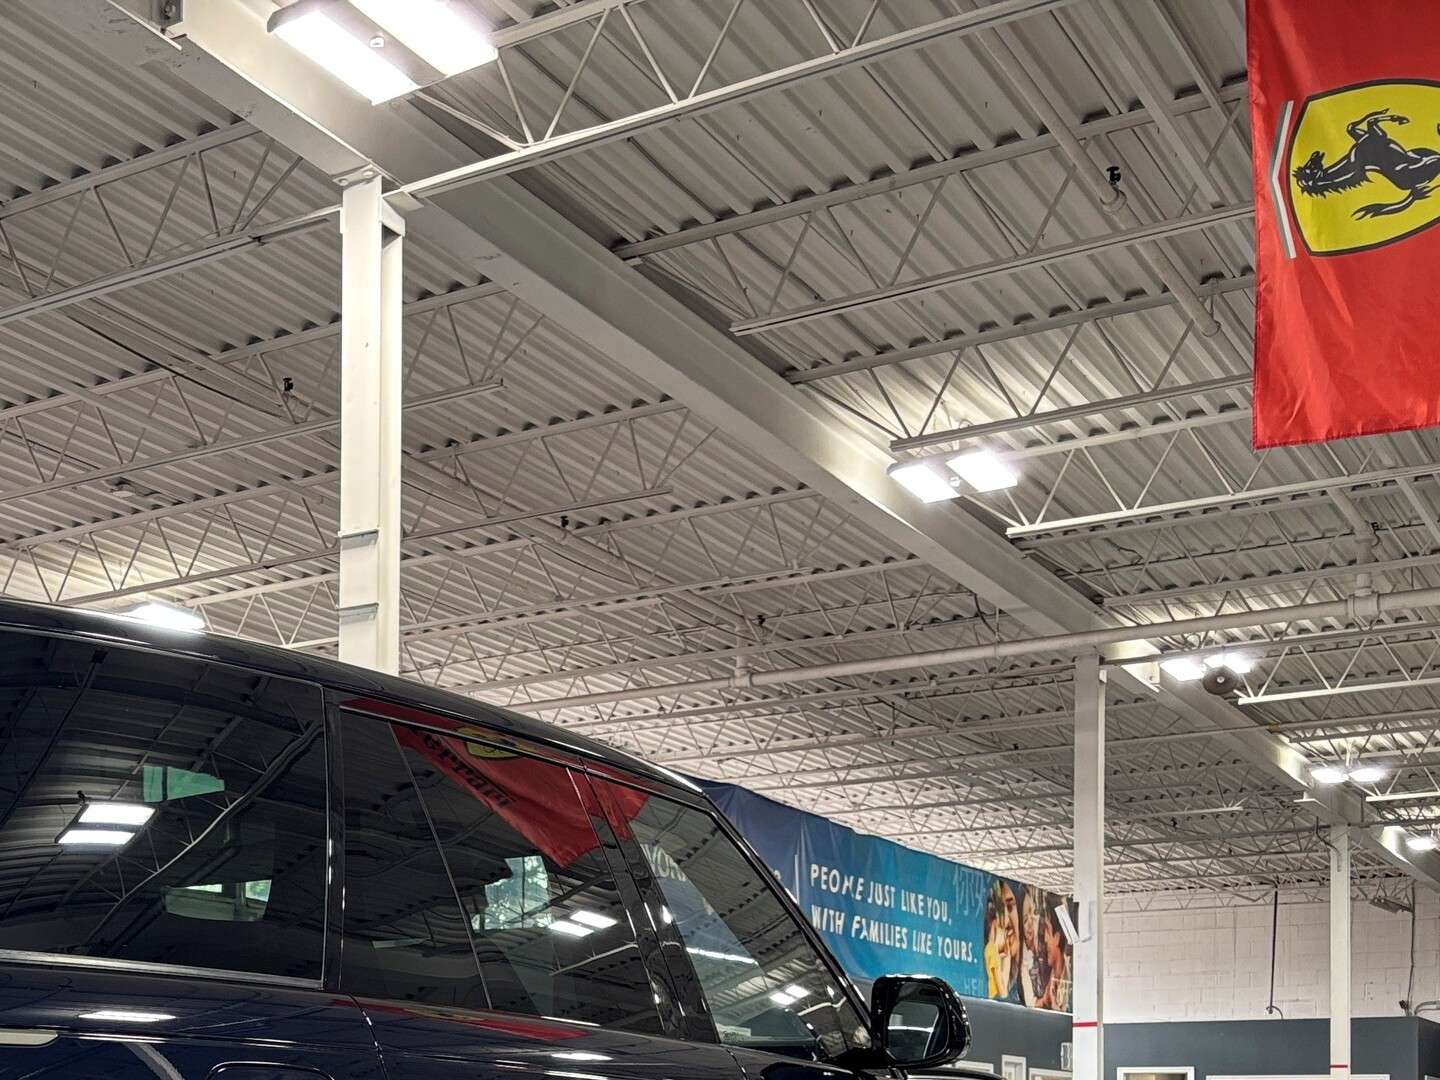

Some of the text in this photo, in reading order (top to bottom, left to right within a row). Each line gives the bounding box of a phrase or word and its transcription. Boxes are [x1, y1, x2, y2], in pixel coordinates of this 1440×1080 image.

[867, 880, 896, 909] JUST
[901, 889, 924, 916] LIKE
[927, 897, 953, 926] YOU,
[810, 904, 978, 964] WITH FAMILIES LIKE YOURS.
